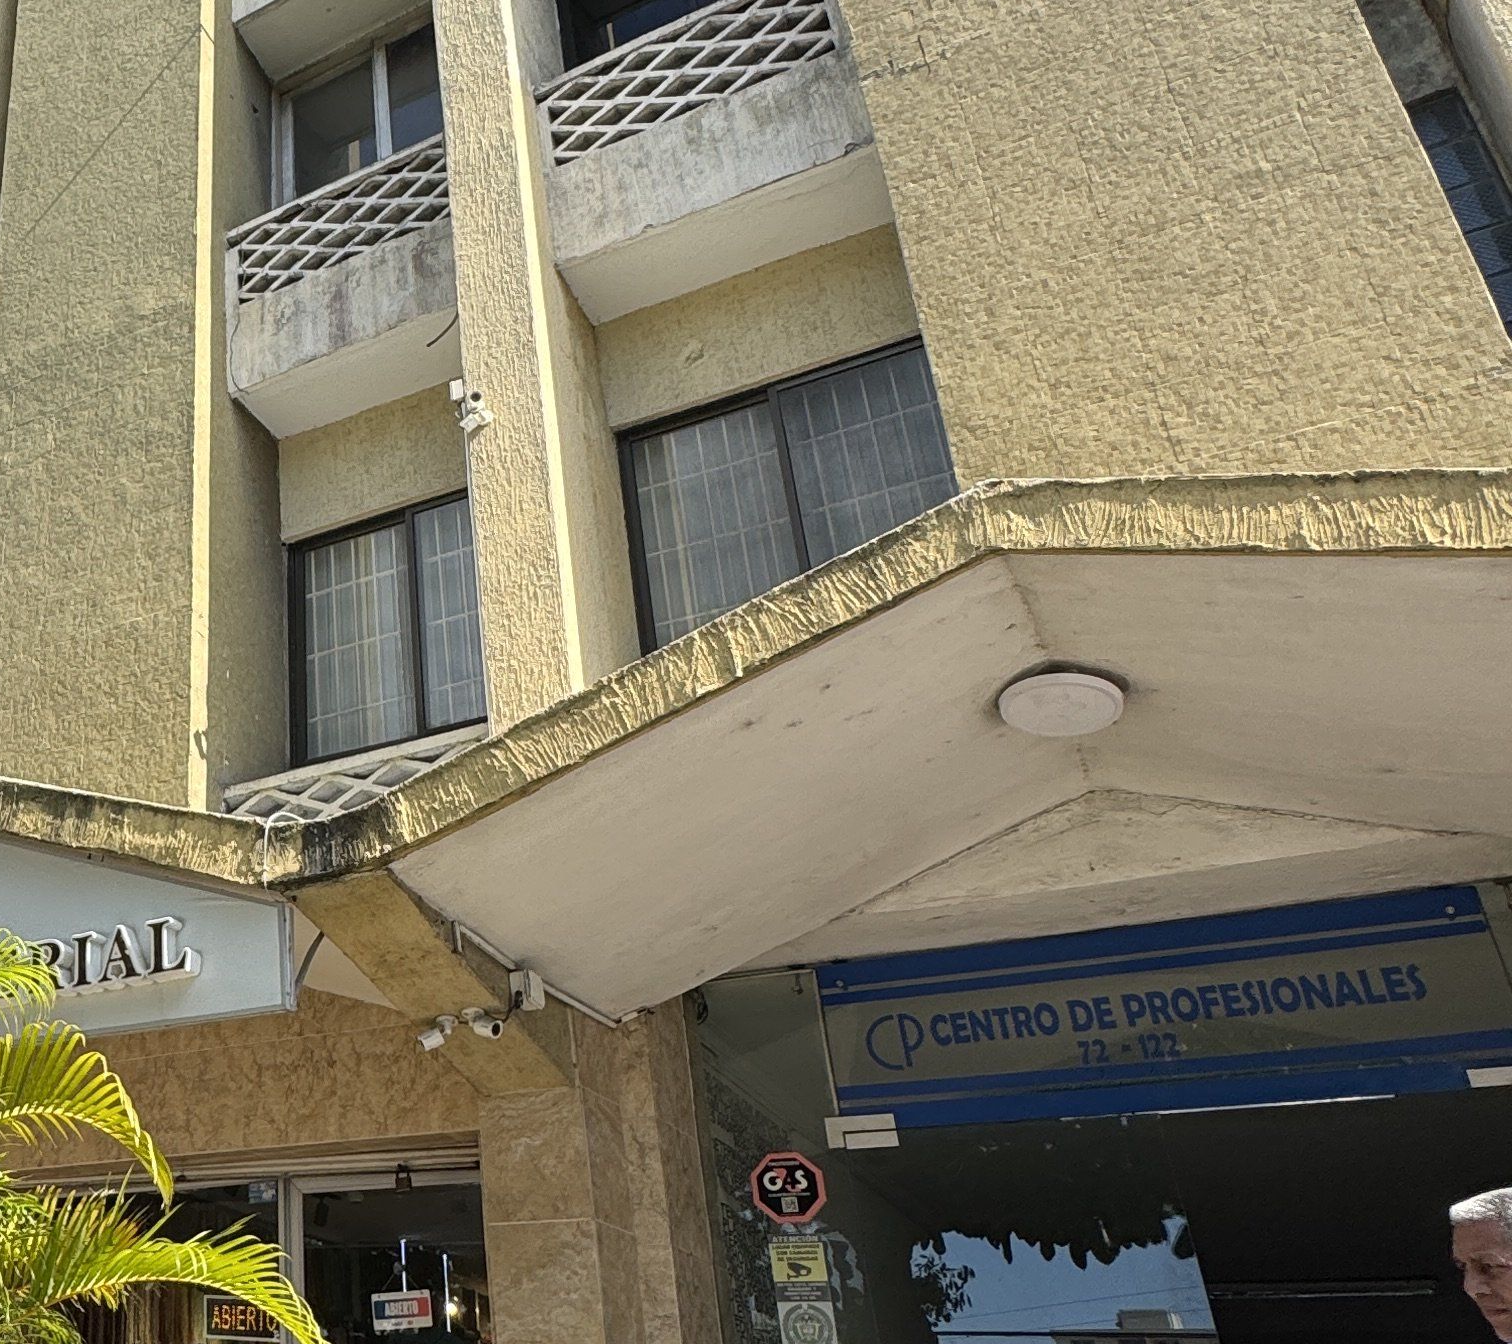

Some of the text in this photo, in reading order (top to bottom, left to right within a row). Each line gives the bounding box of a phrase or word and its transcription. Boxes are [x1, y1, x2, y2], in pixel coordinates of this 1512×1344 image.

[929, 1002, 1061, 1047] CENTRO
[1065, 996, 1118, 1033] DE
[1120, 963, 1428, 1028] PROFESIONALES
[1076, 1038, 1110, 1065] 72
[1138, 1032, 1181, 1061] 122
[211, 1304, 277, 1332] ABIERTO
[384, 1300, 419, 1317] ABIERTO
